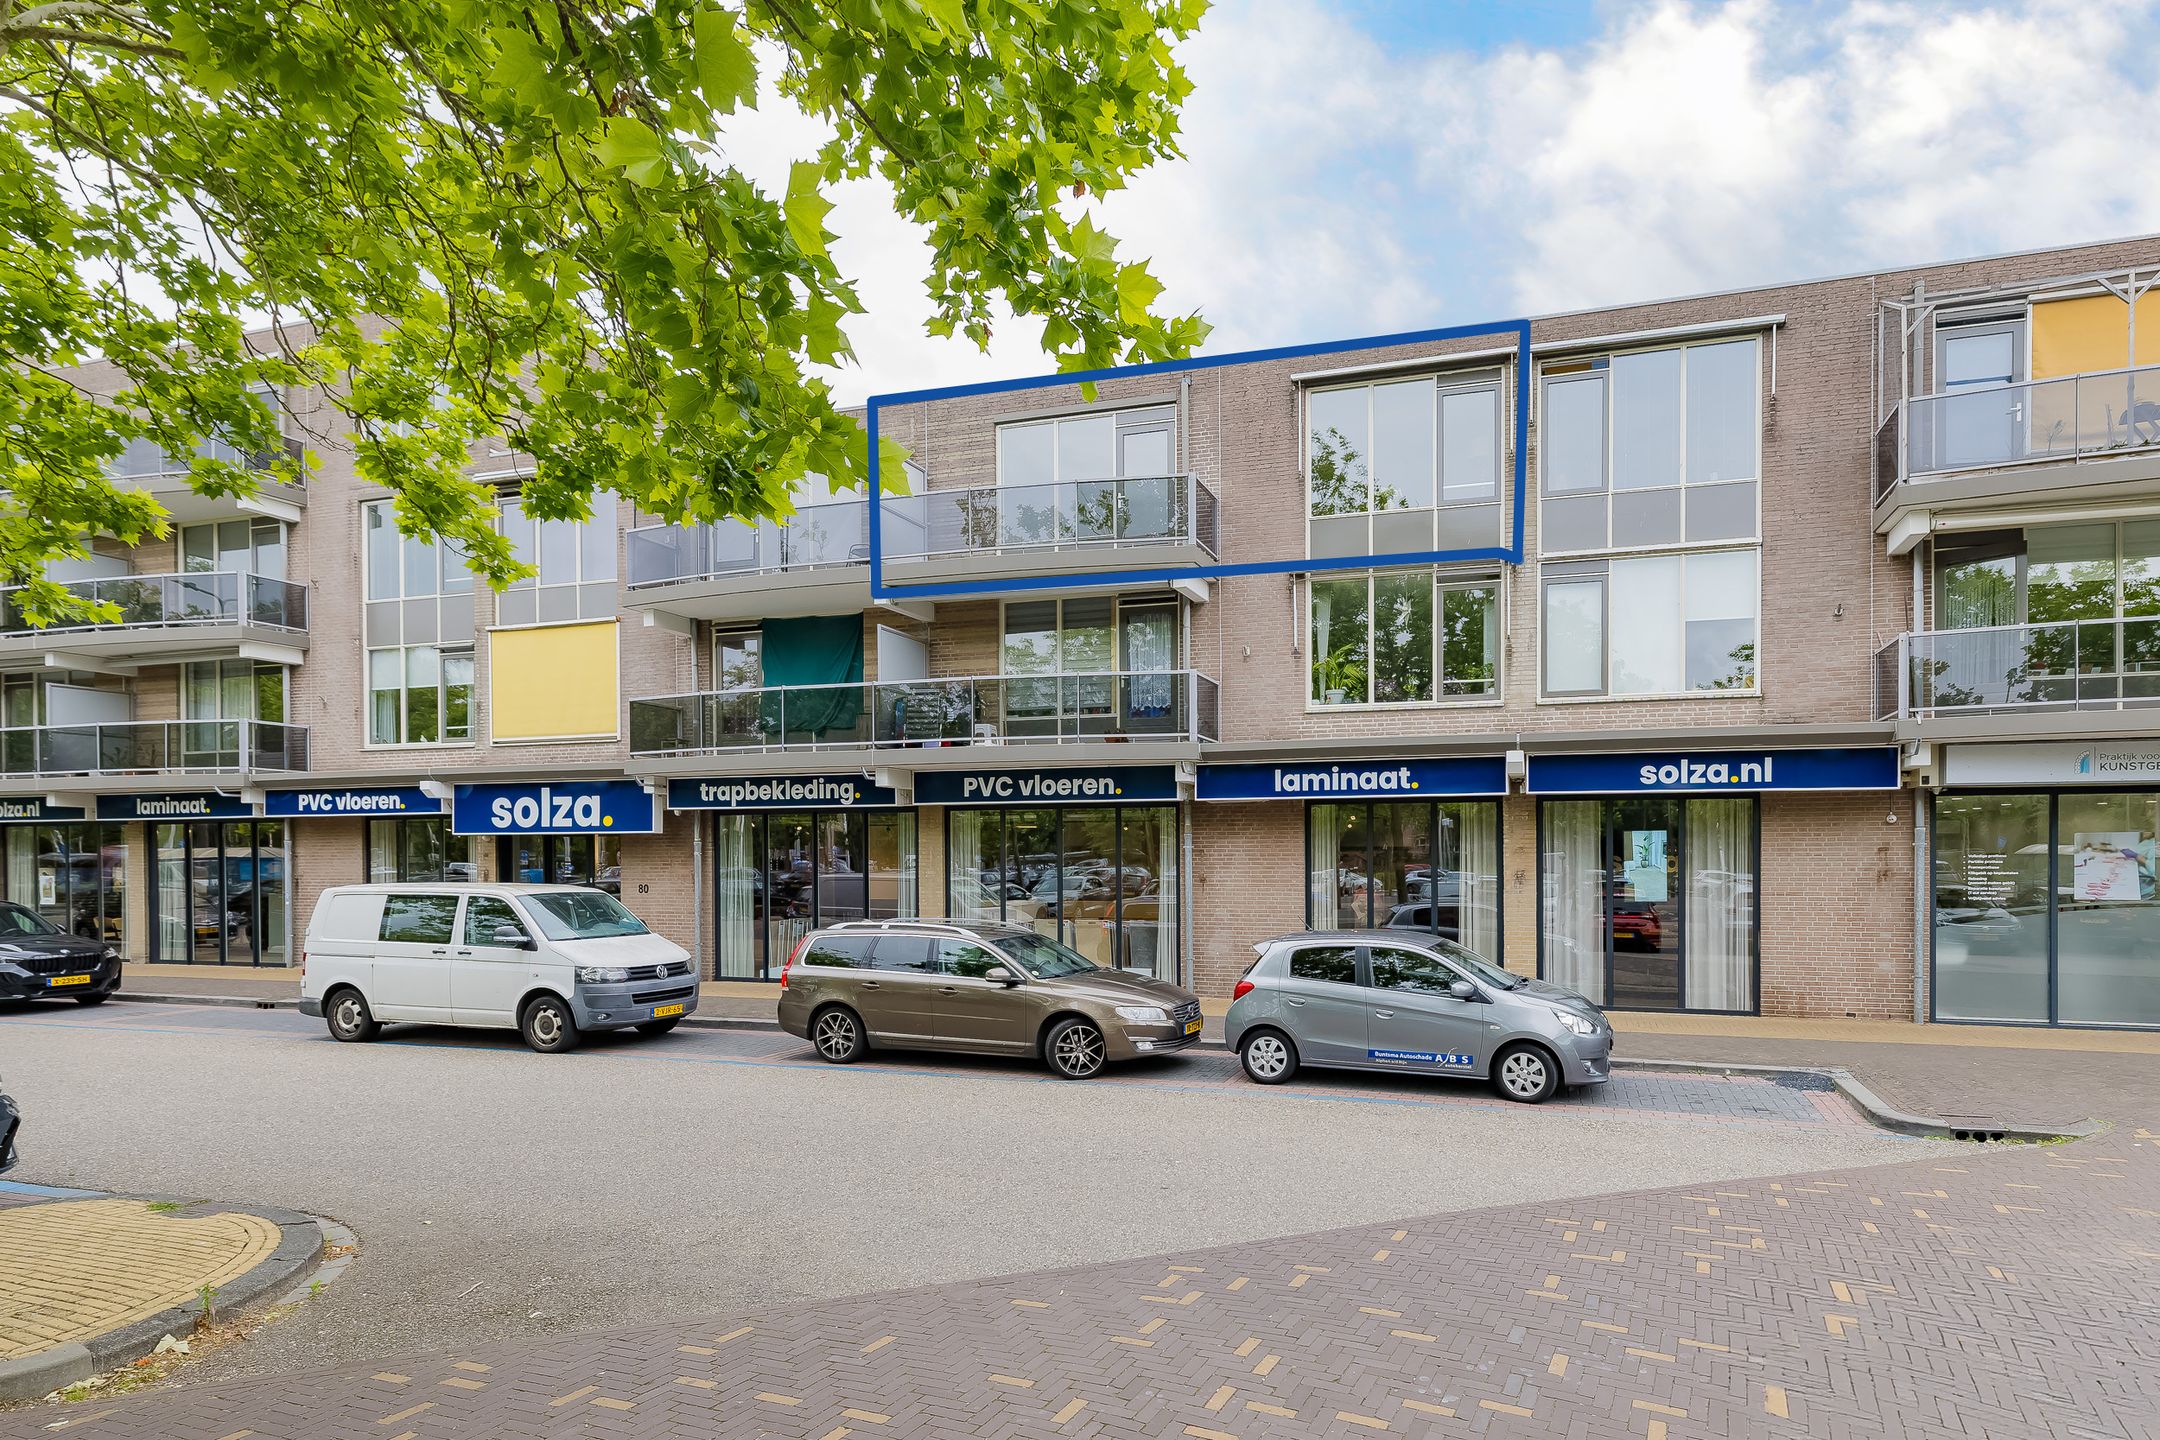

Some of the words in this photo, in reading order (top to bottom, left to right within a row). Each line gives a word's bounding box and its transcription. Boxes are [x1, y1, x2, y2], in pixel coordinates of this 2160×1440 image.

[2100, 753, 2137, 761] Praktijk
[1274, 766, 1419, 792] laminaat.
[1640, 757, 1772, 785] solza.nl
[700, 776, 861, 807] trapbekleding.
[964, 776, 1012, 798] PVC
[1019, 773, 1123, 797] vloeren.
[136, 796, 211, 814] laminaat.
[298, 793, 332, 811] PVC
[336, 792, 406, 810] vloeren.
[491, 787, 614, 828] solza.
[638, 884, 650, 893] 80
